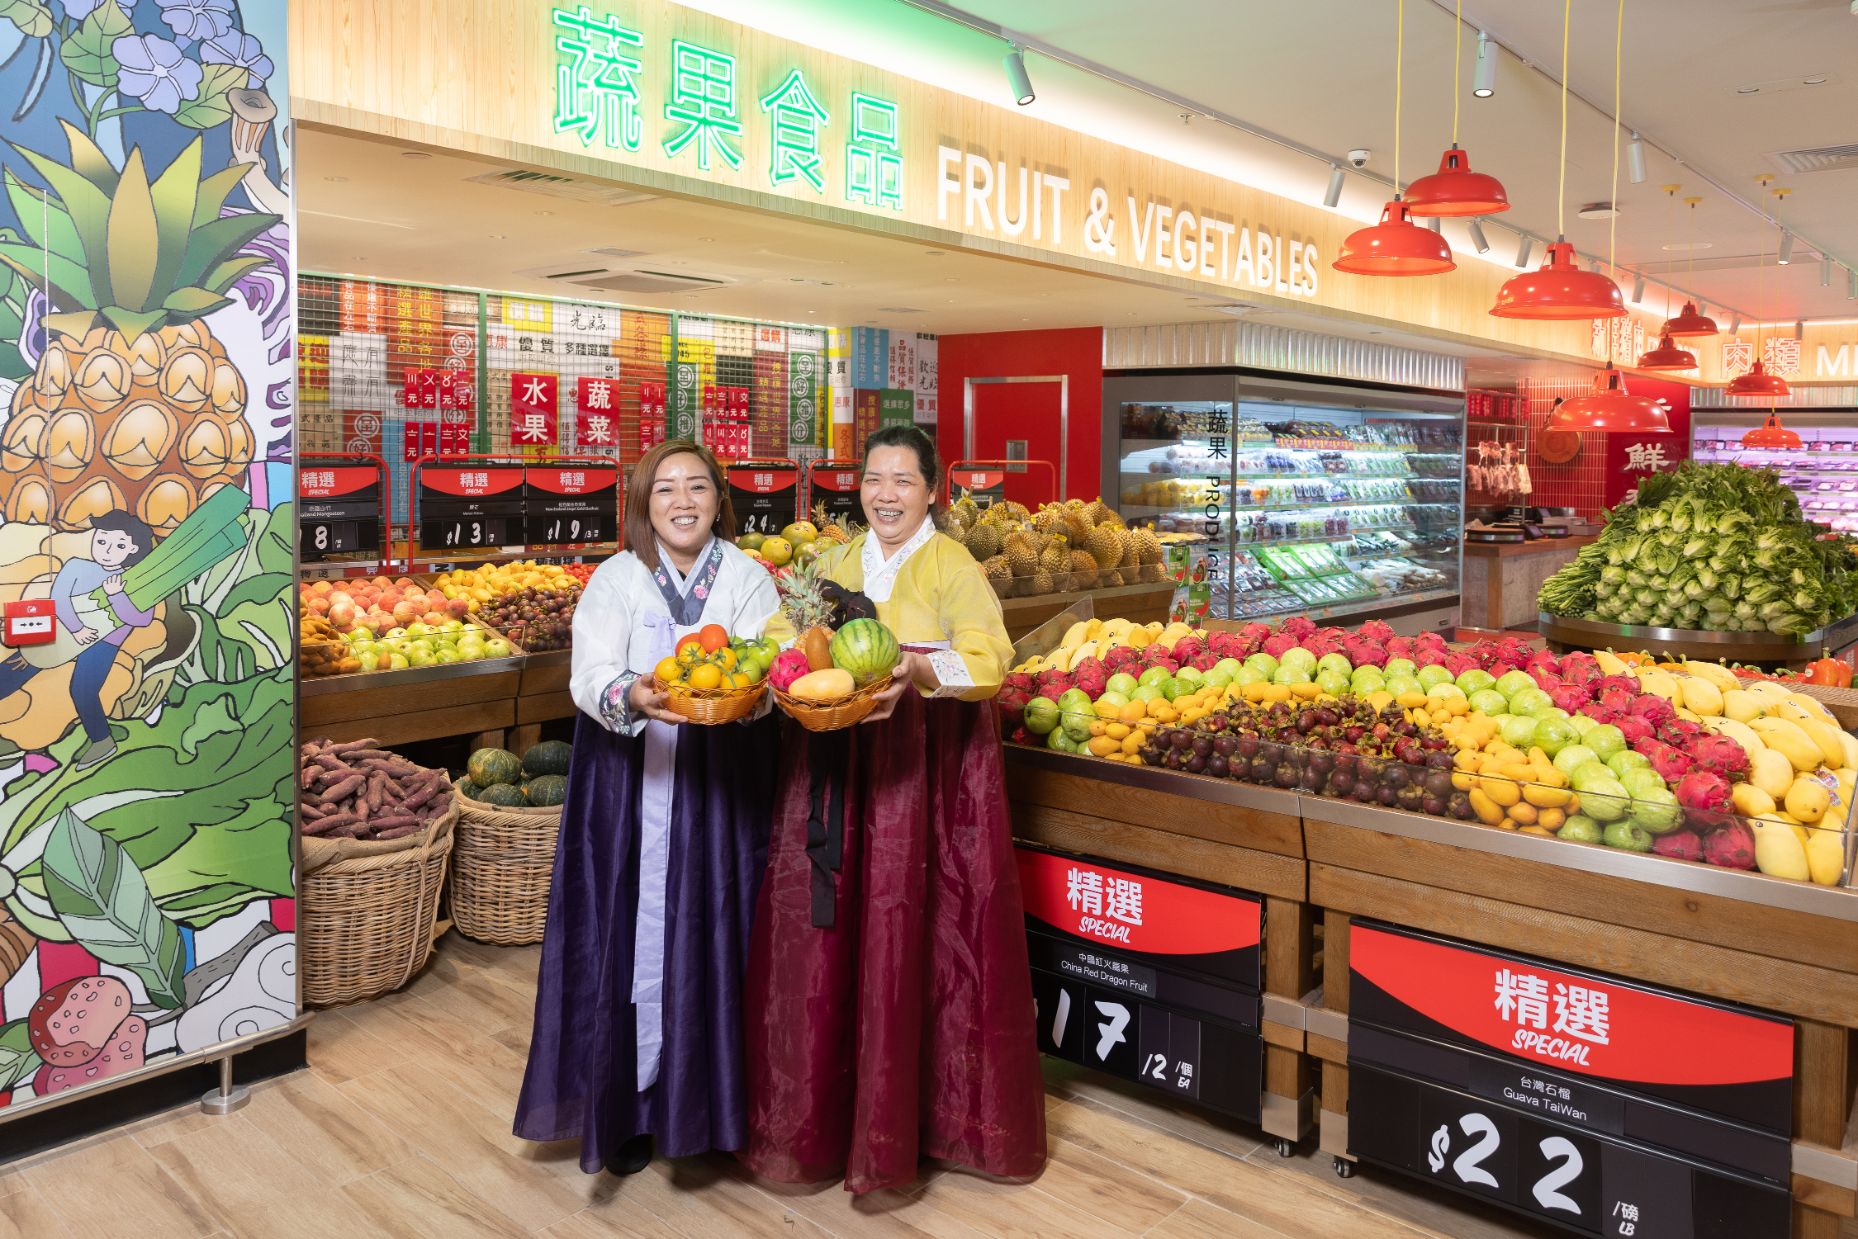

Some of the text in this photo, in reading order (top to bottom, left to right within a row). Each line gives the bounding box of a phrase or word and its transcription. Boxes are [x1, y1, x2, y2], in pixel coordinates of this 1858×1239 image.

[553, 6, 905, 211] 蔬果食品
[938, 144, 1320, 299] FRUIT & VEGETABLES
[1816, 344, 1858, 376] M
[521, 377, 549, 442] 水果
[587, 381, 612, 443] 蔬菜
[1207, 408, 1229, 460] 蔬果
[301, 471, 336, 488] 精選
[459, 472, 489, 488] 精選
[559, 471, 586, 487] 精選
[1067, 867, 1143, 926] 精選
[1078, 916, 1131, 944] SPECIAL
[1061, 960, 1148, 993] China Red Dragon Fruit
[1034, 987, 1131, 1062] 17
[1494, 968, 1610, 1046] 精選
[1511, 1028, 1591, 1067] SPECIAL
[1503, 1087, 1587, 1121] Guava TaiWan
[1520, 1075, 1571, 1101] 台灣石榴
[1618, 1220, 1636, 1237] LB
